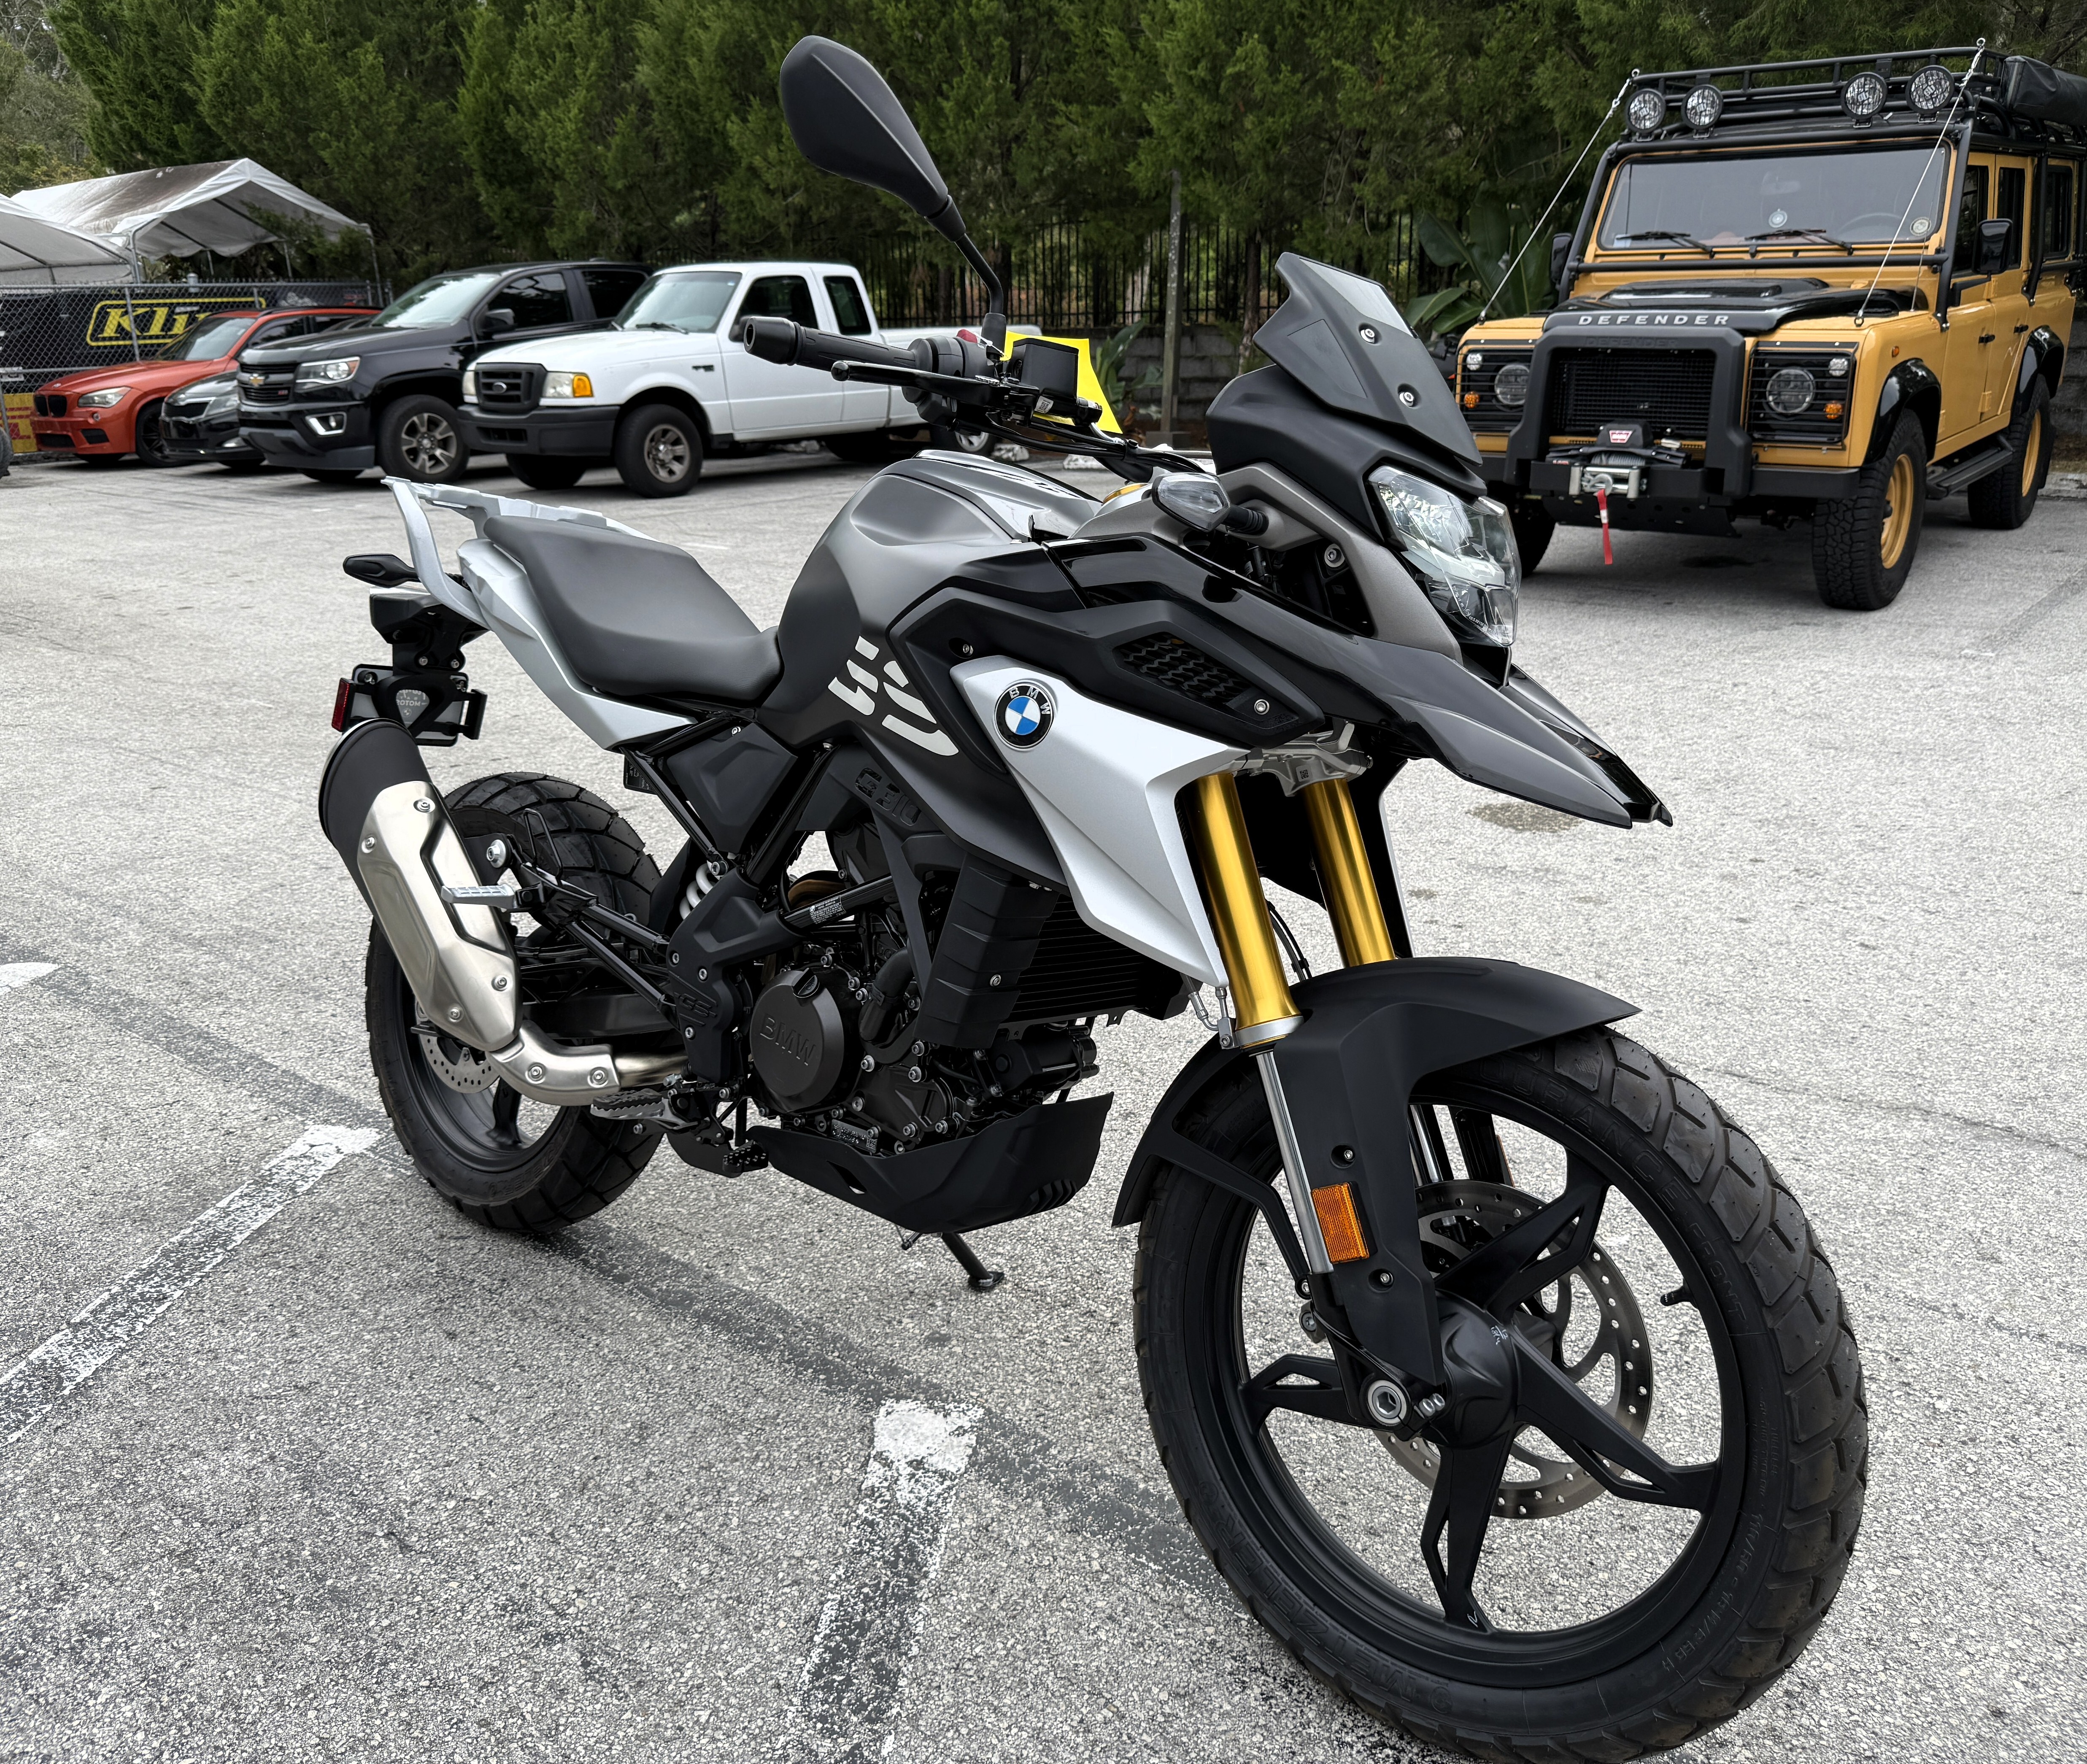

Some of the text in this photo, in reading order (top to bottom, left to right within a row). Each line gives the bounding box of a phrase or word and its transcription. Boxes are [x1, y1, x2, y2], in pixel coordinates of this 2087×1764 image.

[1578, 315, 1729, 325] DEFENDER
[1585, 337, 1679, 348] DEFENDER
[1009, 687, 1050, 715] BMW
[760, 1013, 817, 1066] BMW
[1686, 1222, 1746, 1321] FRONT
[1214, 1515, 1417, 1701] METZELER
